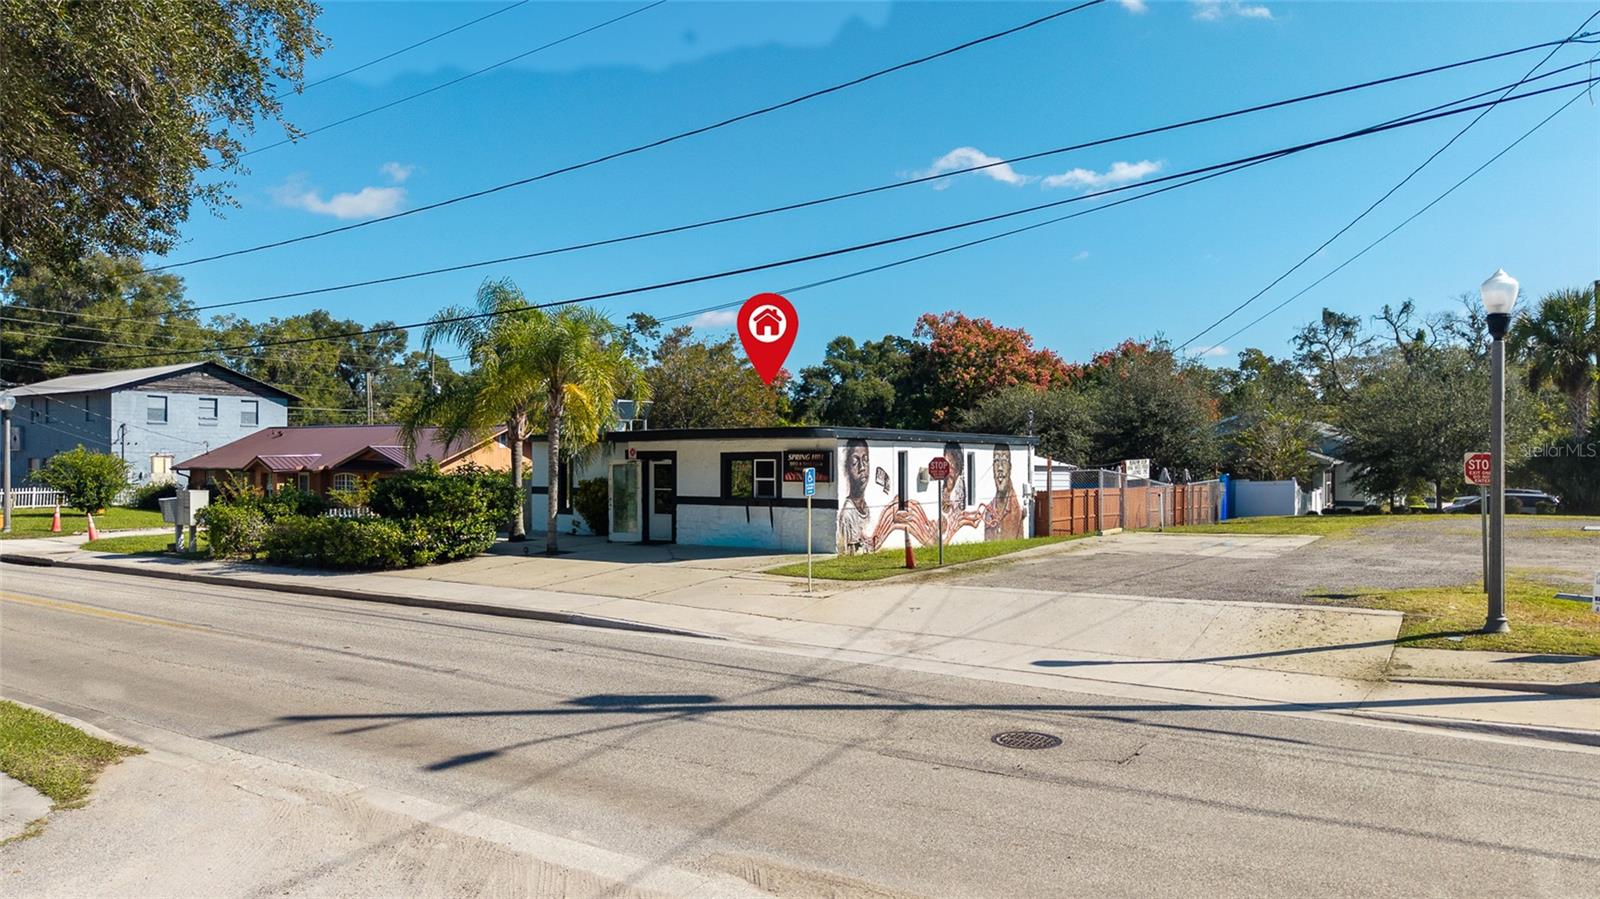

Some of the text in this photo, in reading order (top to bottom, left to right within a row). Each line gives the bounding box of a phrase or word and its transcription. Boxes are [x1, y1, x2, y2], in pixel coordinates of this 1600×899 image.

[788, 453, 810, 461] SPRING
[930, 461, 948, 470] STOP
[1468, 459, 1489, 470] STO
